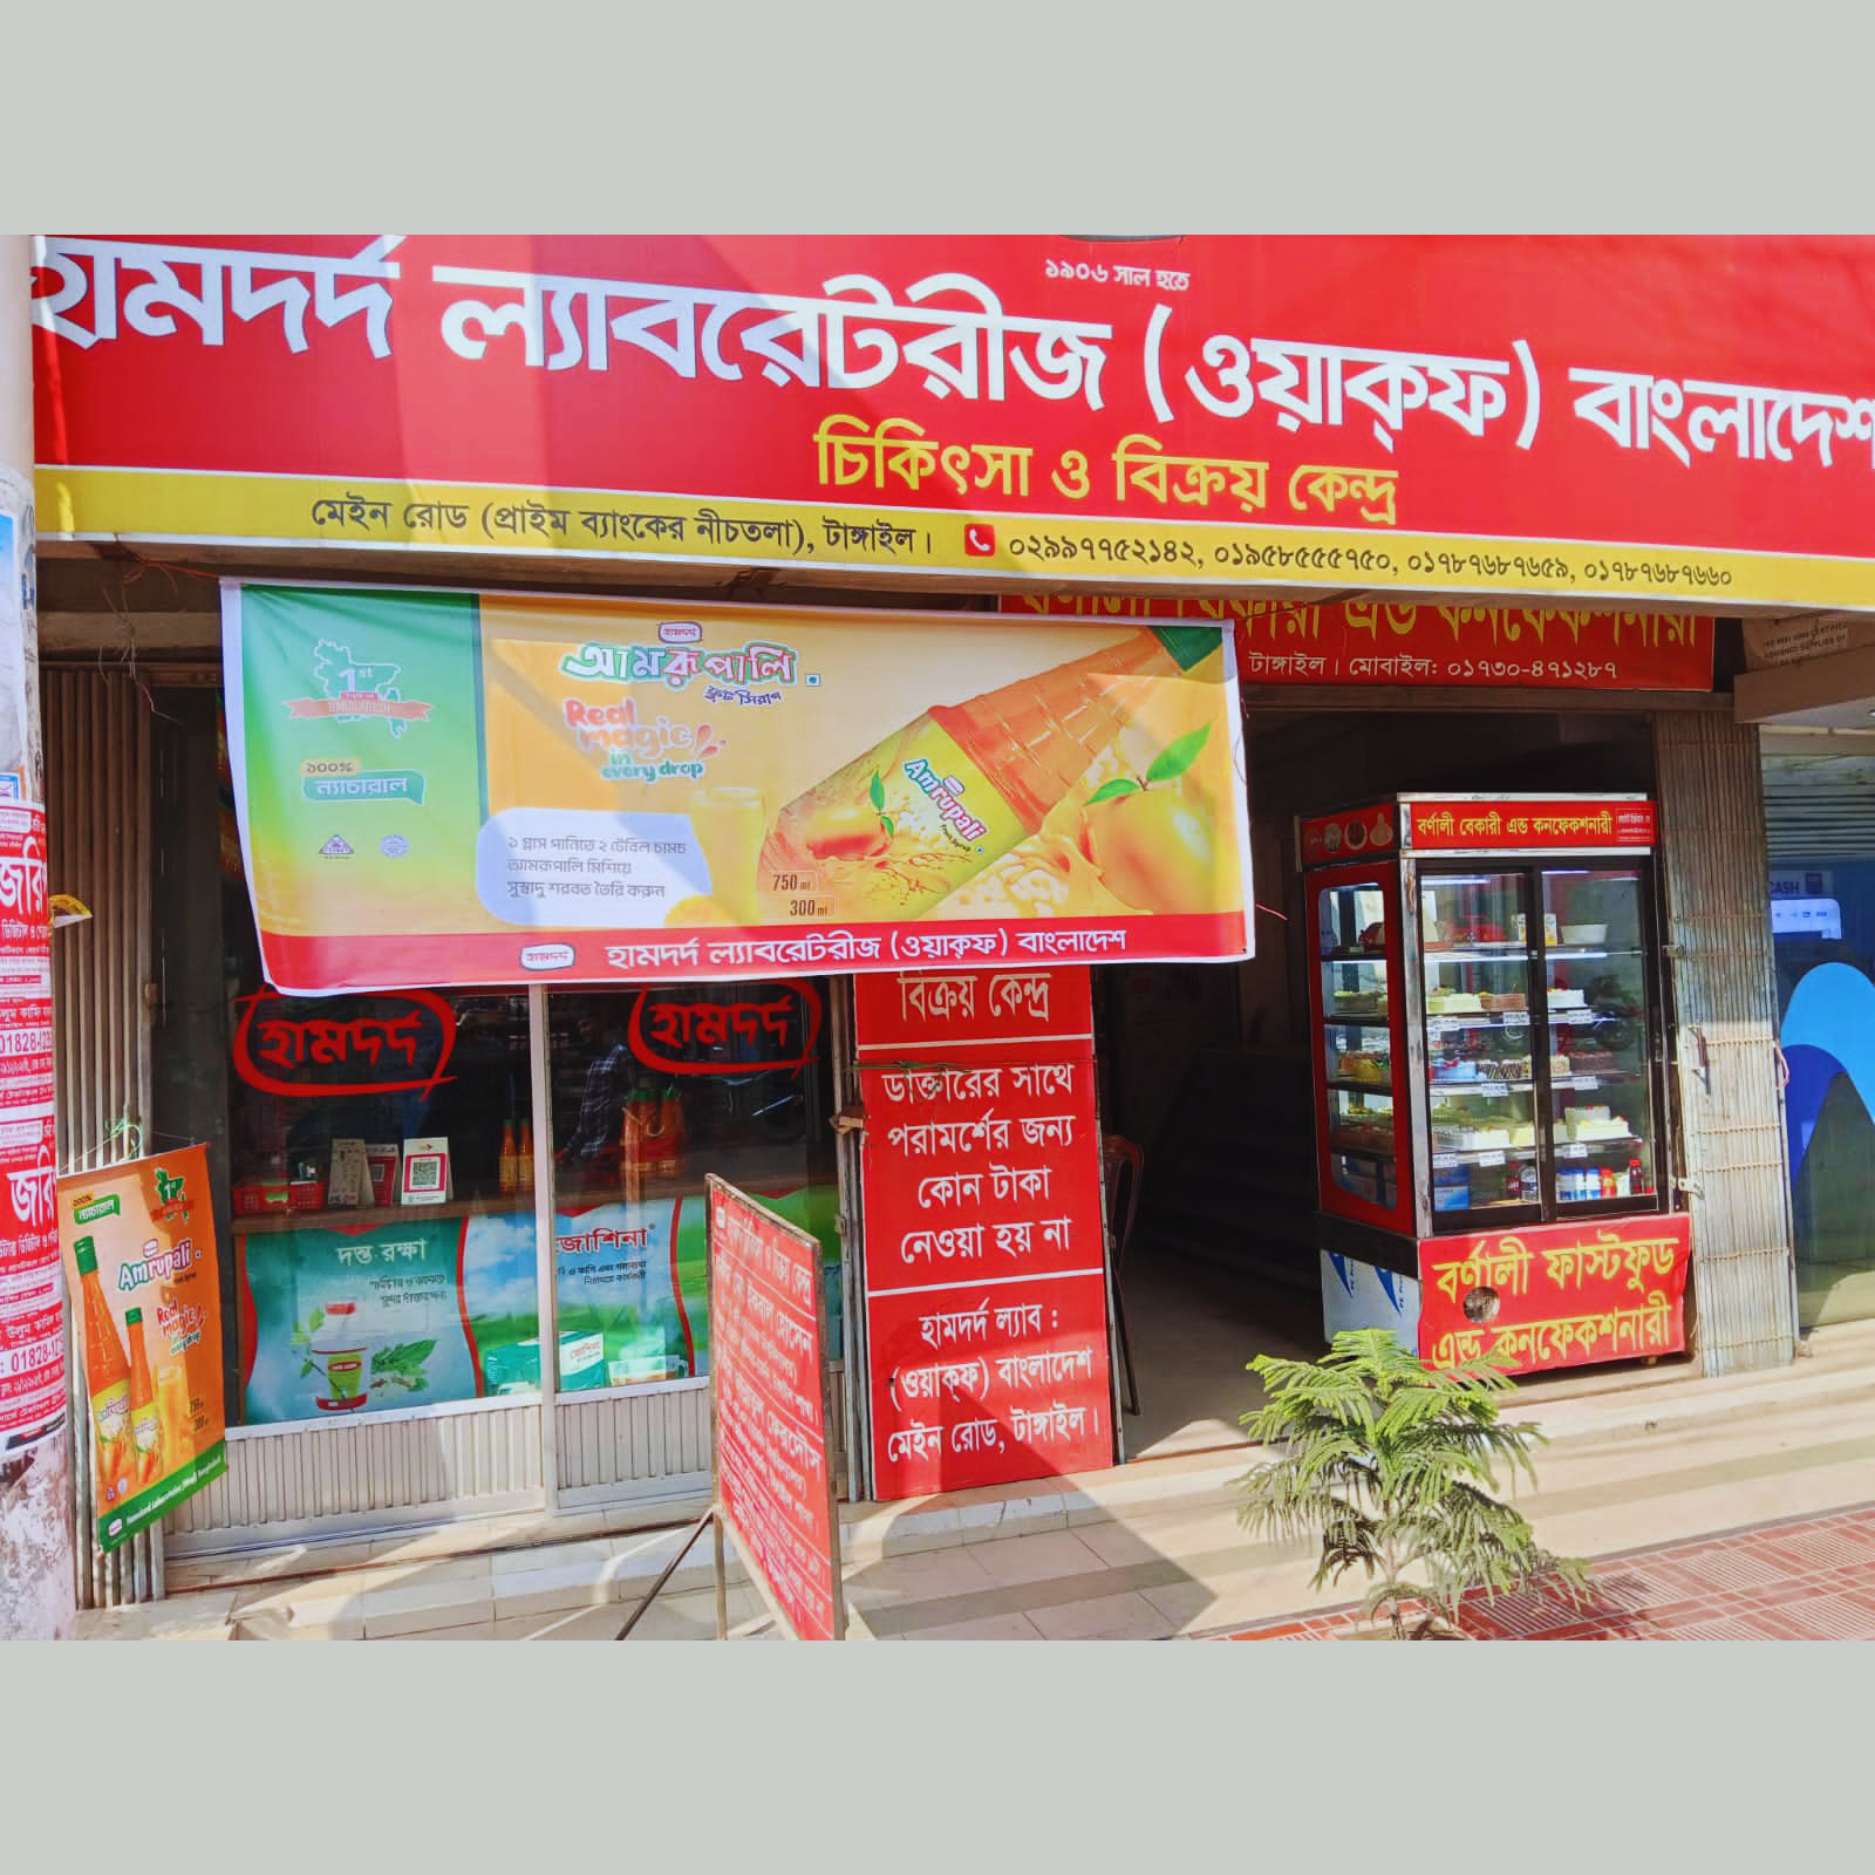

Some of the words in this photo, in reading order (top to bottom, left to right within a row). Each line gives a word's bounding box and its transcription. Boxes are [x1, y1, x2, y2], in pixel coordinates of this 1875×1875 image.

[1045, 258, 1109, 283] ১৯০৬
[1113, 265, 1151, 287] সাল
[1155, 269, 1191, 291] হতে
[31, 235, 405, 358] হামদর্দ
[432, 266, 1112, 411] ল্যাবরেটরীজ
[1568, 367, 1875, 469] বাংলাদেশ
[813, 414, 1033, 497] চিকিৎসা
[1051, 450, 1090, 499] ও
[1112, 434, 1269, 510] বিক্রয়
[1288, 465, 1398, 525] কেন্দ্র
[312, 491, 393, 530] মেইন
[403, 502, 469, 529] রোড
[482, 502, 571, 539] (প্রাইম
[578, 510, 686, 542] ব্যাংকের
[694, 508, 814, 555] নীচতলা),
[822, 515, 916, 555] টাঙ্গাইল
[1009, 535, 1204, 569] ০২৯৯৭৭৫২১৪২,
[1214, 543, 1398, 576] ০১৯৫৮৫৫৫৭৫০,
[1408, 551, 1576, 584] ০১৭৮৭৬৮৭৬৫৯,
[1584, 560, 1732, 586] ০১৭৮৭৬৮৭৬৬০
[338, 665, 374, 692] 1st
[1249, 652, 1327, 676] টাঙ্গাইল
[1447, 659, 1618, 681] ০১৭৩০-৪৭১২৮৭
[565, 699, 637, 727] Real
[734, 689, 782, 705] সিরাপ
[579, 717, 694, 757] magic
[306, 762, 353, 774] ১০০%
[601, 761, 656, 782] every
[658, 760, 704, 780] drop
[610, 749, 632, 766] in
[315, 776, 407, 796] ন্যাচারাল
[903, 757, 988, 843] Amrupali
[1416, 811, 1454, 837] বর্ণালী
[1460, 810, 1502, 836] বেকারী
[1533, 810, 1613, 836] কনফেকশনারী
[550, 835, 596, 852] পানিতে
[611, 838, 650, 854] টেবিল
[653, 842, 687, 854] চামচ
[586, 858, 632, 875] মিশিয়ে
[772, 874, 798, 890] 750
[549, 883, 591, 896] শরবত
[595, 880, 625, 897] তৈরি
[627, 885, 666, 897] করুন
[789, 900, 816, 916] 300
[606, 938, 700, 969] হামদর্দ
[707, 930, 881, 964] ল্যাবরেটরীজ
[1016, 930, 1127, 954] বাংলাদেশ
[989, 973, 1052, 1021] কেন্দ্র
[257, 1010, 423, 1069] হামদর্দ
[648, 995, 793, 1048] হামদর্দ
[882, 1068, 1002, 1104] ডাক্তারের
[1011, 1063, 1074, 1098] সাথে
[888, 1108, 1012, 1157] পরামর্শের
[1019, 1115, 1076, 1147] জন্য
[918, 1172, 984, 1208] কোন
[989, 1162, 1053, 1202] টাকা
[337, 1242, 373, 1266] দন্ত
[384, 1238, 427, 1263] রক্ষা
[901, 1221, 984, 1264] নেওয়া
[992, 1221, 1034, 1257] হয়
[1040, 1215, 1071, 1250] না
[119, 1240, 191, 1290] Amrupali
[1432, 1236, 1535, 1303] বর্ণালী
[1542, 1229, 1679, 1293] ফাস্টফুড
[919, 1297, 990, 1349] হামদর্দ
[994, 1303, 1043, 1339] ল্যাব
[1491, 1290, 1672, 1364] কনফেকশনারী
[996, 1346, 1092, 1389] বাংলাদেশ
[887, 1418, 944, 1462] মেইন
[951, 1418, 1005, 1454] রোড,
